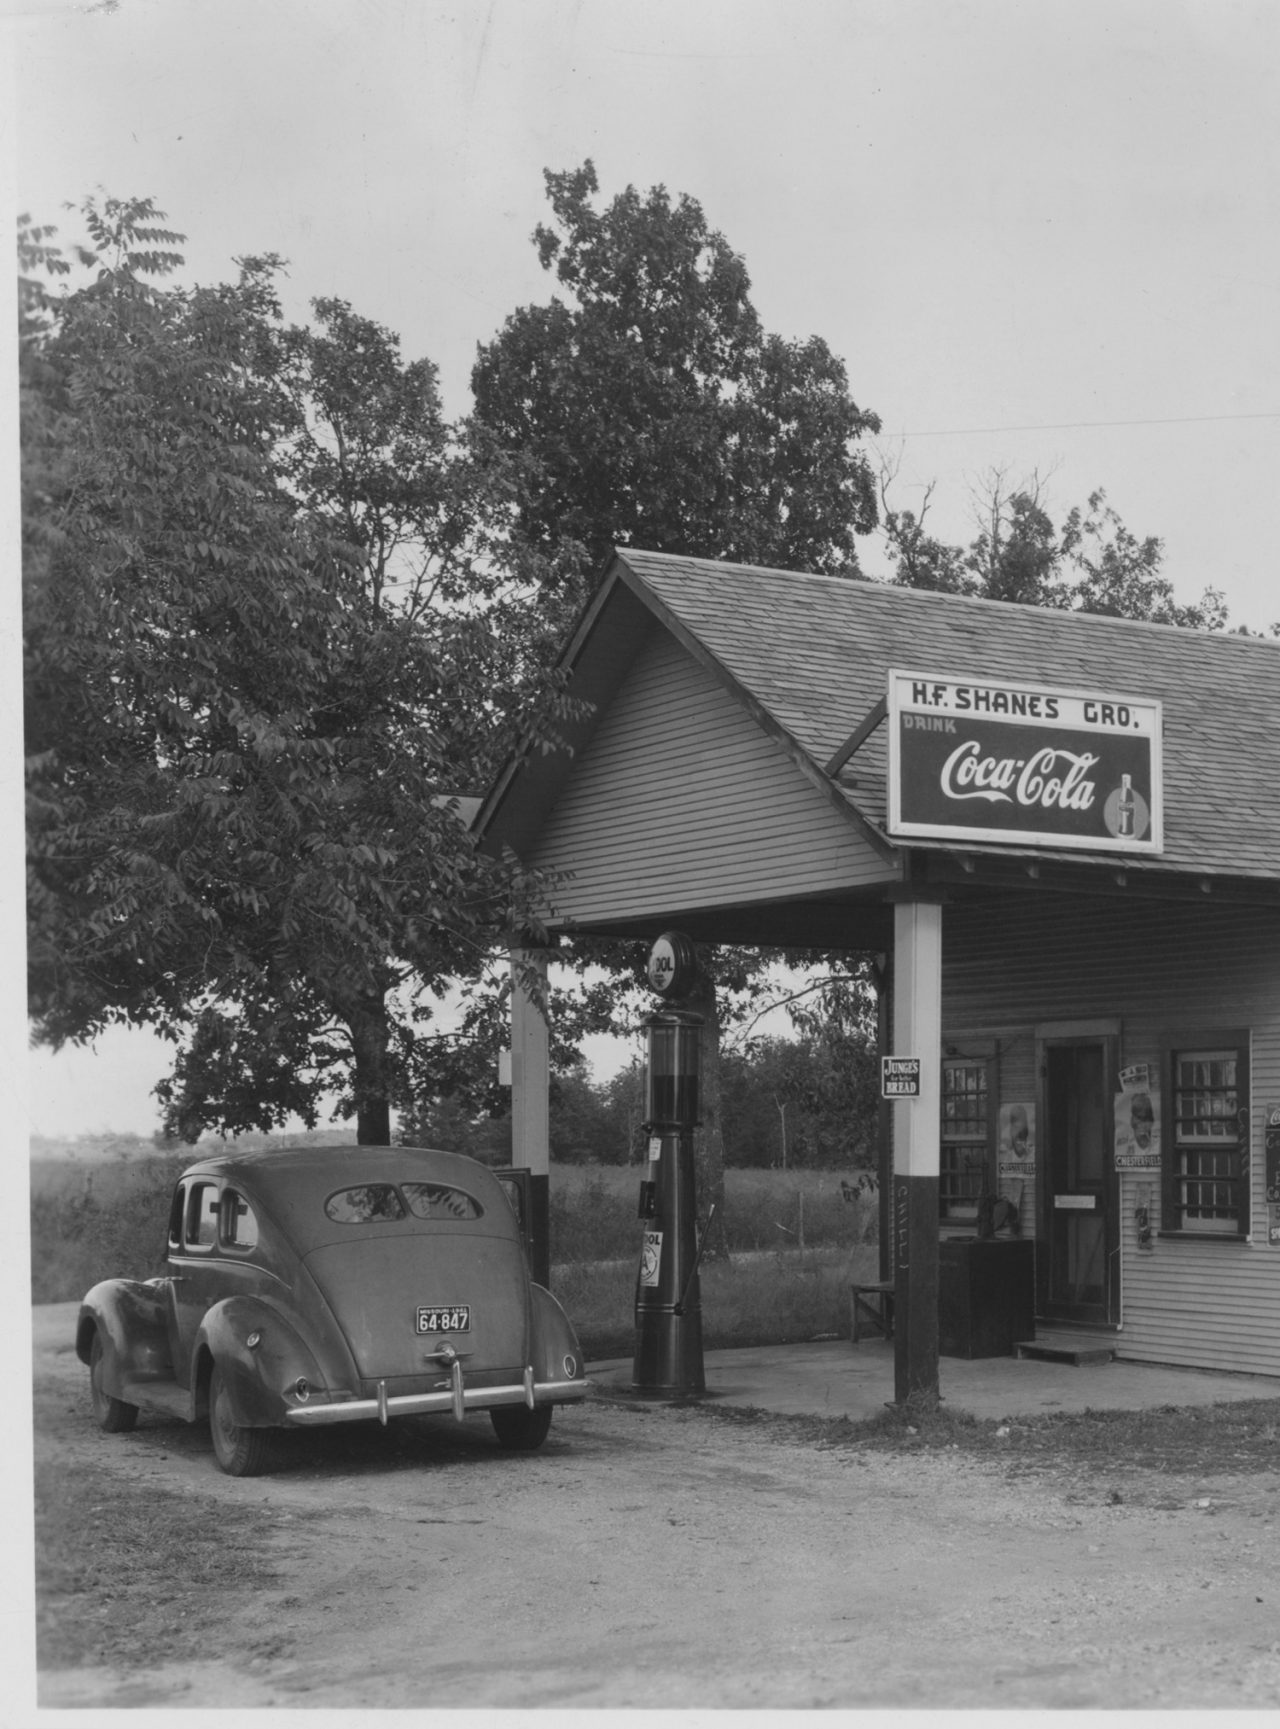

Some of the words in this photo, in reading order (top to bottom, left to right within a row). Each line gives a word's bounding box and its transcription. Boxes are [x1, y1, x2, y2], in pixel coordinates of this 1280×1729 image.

[912, 682, 948, 707] H.F.
[955, 687, 1059, 719] SHANES
[1083, 701, 1139, 728] GRO.
[902, 714, 957, 734] DRINK
[940, 740, 1100, 810] Coca-Cola
[886, 1082, 917, 1094] BREAD
